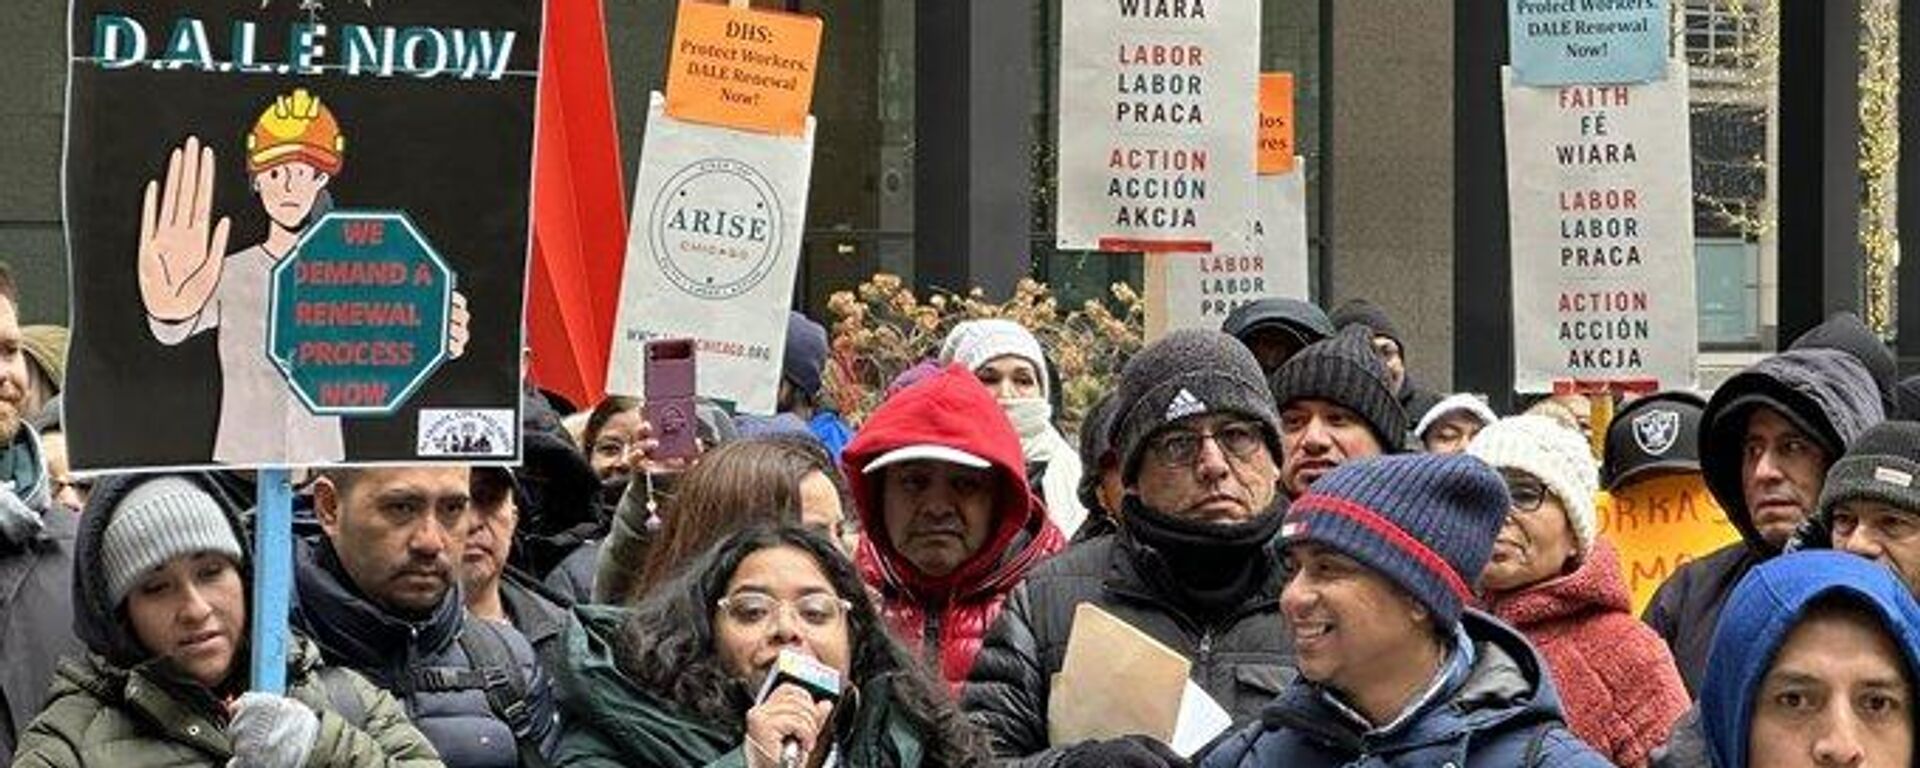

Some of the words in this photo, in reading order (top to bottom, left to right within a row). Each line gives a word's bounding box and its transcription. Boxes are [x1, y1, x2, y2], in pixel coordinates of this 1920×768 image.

[1119, 0, 1206, 19] WIARA
[725, 19, 774, 44] DHS:
[1527, 20, 1571, 37] DALE
[1575, 17, 1648, 35] Renewal
[340, 24, 516, 80] NOW
[680, 38, 738, 61] Protect
[1118, 45, 1203, 66] LABOR
[1566, 42, 1608, 58] Now!
[686, 61, 731, 81] DALE
[733, 68, 798, 91] Renewal
[1118, 74, 1202, 95] LABOR
[720, 87, 761, 106] Now!
[1558, 87, 1629, 108] FAITH
[1117, 102, 1203, 124] PRACA
[1580, 115, 1607, 136] FÉ
[1109, 149, 1206, 171] ACTION
[1556, 144, 1637, 166] WIARA
[1108, 174, 1205, 199] ACCIÓN
[1559, 190, 1638, 211] LABOR
[667, 206, 767, 242] ARISE
[1116, 206, 1197, 228] AKCJA
[342, 221, 385, 244] WE
[1561, 218, 1639, 239] LABOR
[1200, 256, 1265, 273] LABOR
[1561, 246, 1642, 267] PRACA
[296, 261, 407, 285] DEMAND
[414, 263, 433, 286] A
[1200, 277, 1265, 295] LABOR
[1200, 299, 1253, 317] PRA
[1558, 292, 1648, 312] ACTION
[295, 302, 422, 326] RENEWAL
[1559, 315, 1649, 340] ACCIÓN
[298, 341, 414, 365] PROCESS
[1567, 349, 1642, 369] AKCJA
[319, 381, 389, 405] NOW
